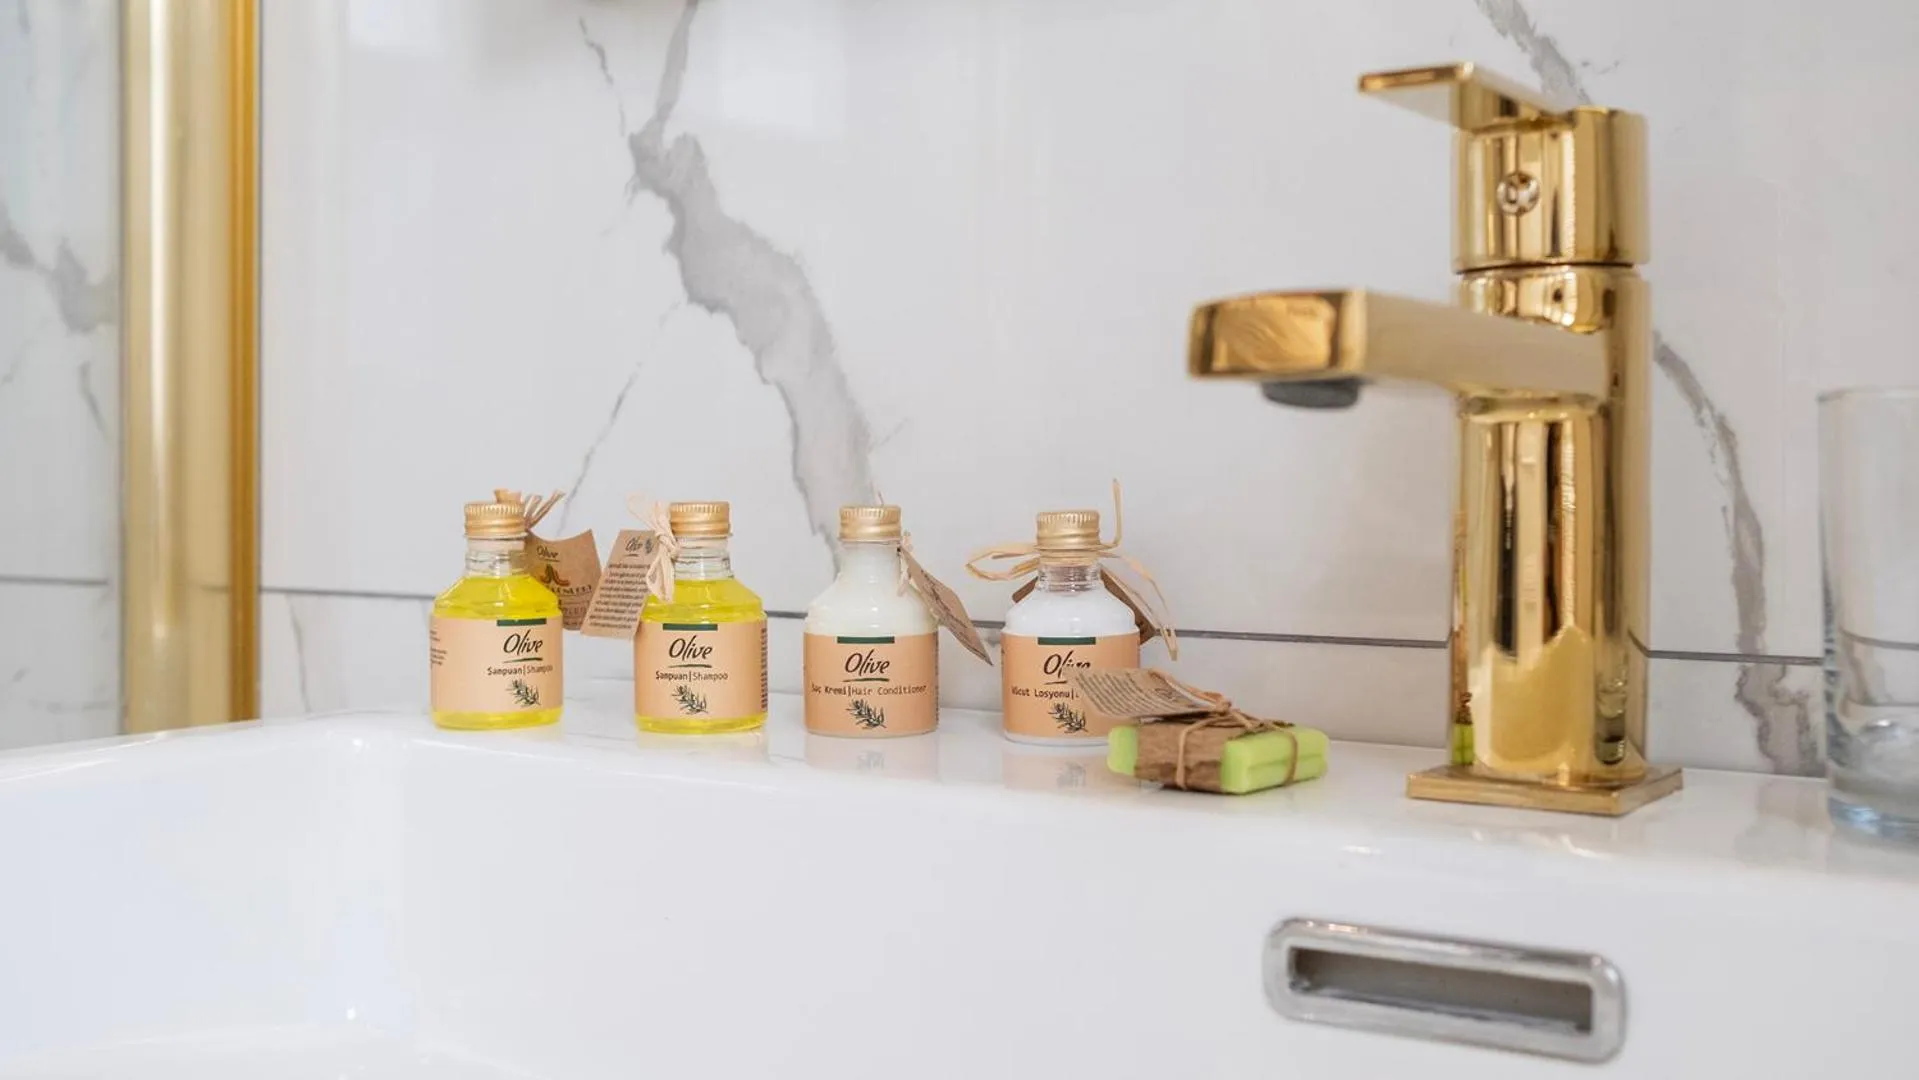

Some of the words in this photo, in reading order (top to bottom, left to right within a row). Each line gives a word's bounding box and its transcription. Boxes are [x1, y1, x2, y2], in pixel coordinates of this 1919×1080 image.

[503, 629, 543, 656] Olive
[668, 635, 713, 661] Olive
[844, 649, 890, 676] Olive
[878, 685, 927, 696] Conditioner
